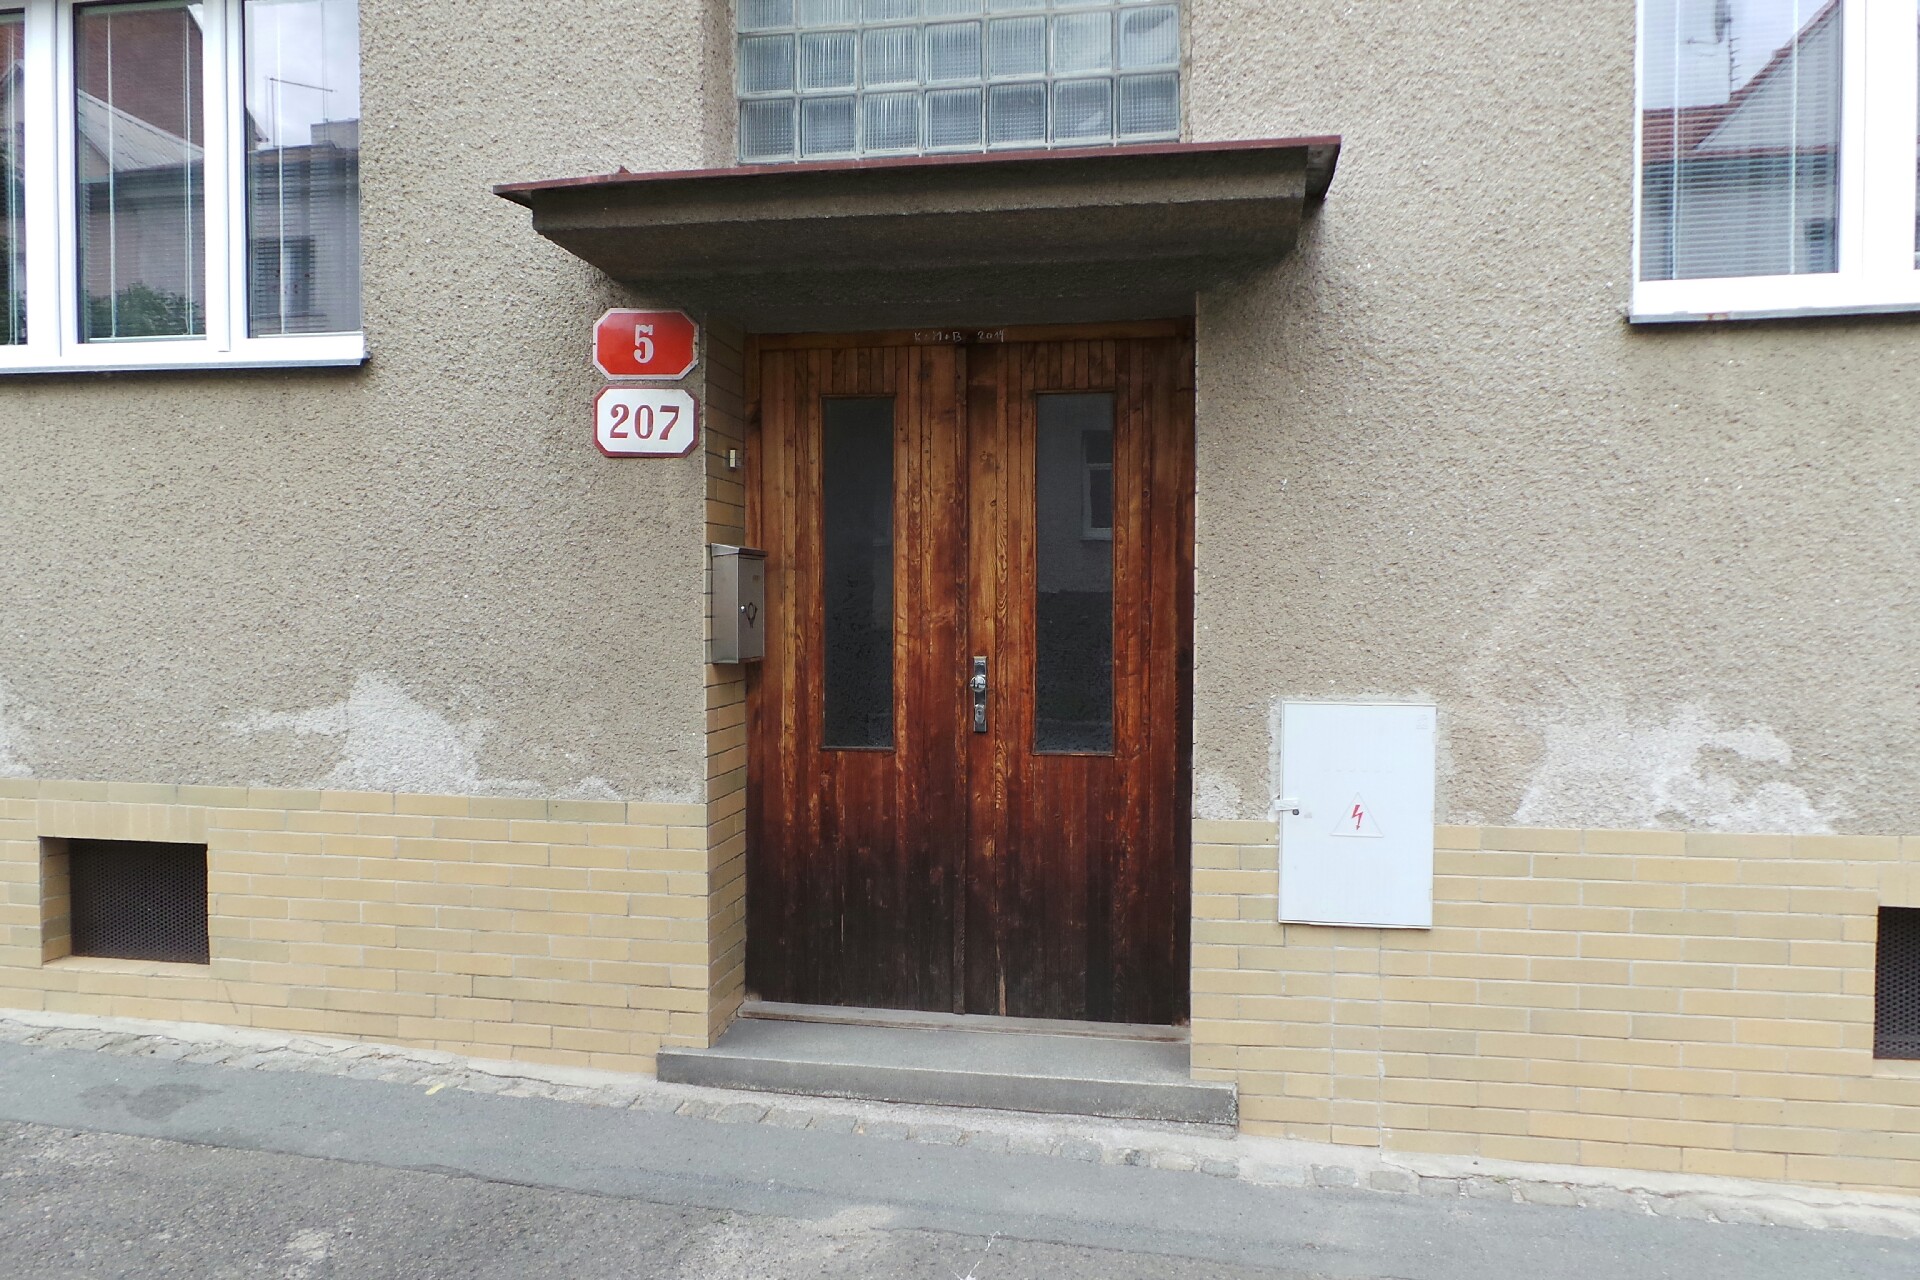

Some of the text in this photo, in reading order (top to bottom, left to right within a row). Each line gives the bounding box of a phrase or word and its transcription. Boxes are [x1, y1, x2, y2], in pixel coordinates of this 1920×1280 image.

[633, 324, 654, 364] 5
[977, 328, 1005, 343] 2014
[609, 403, 680, 441] 207
